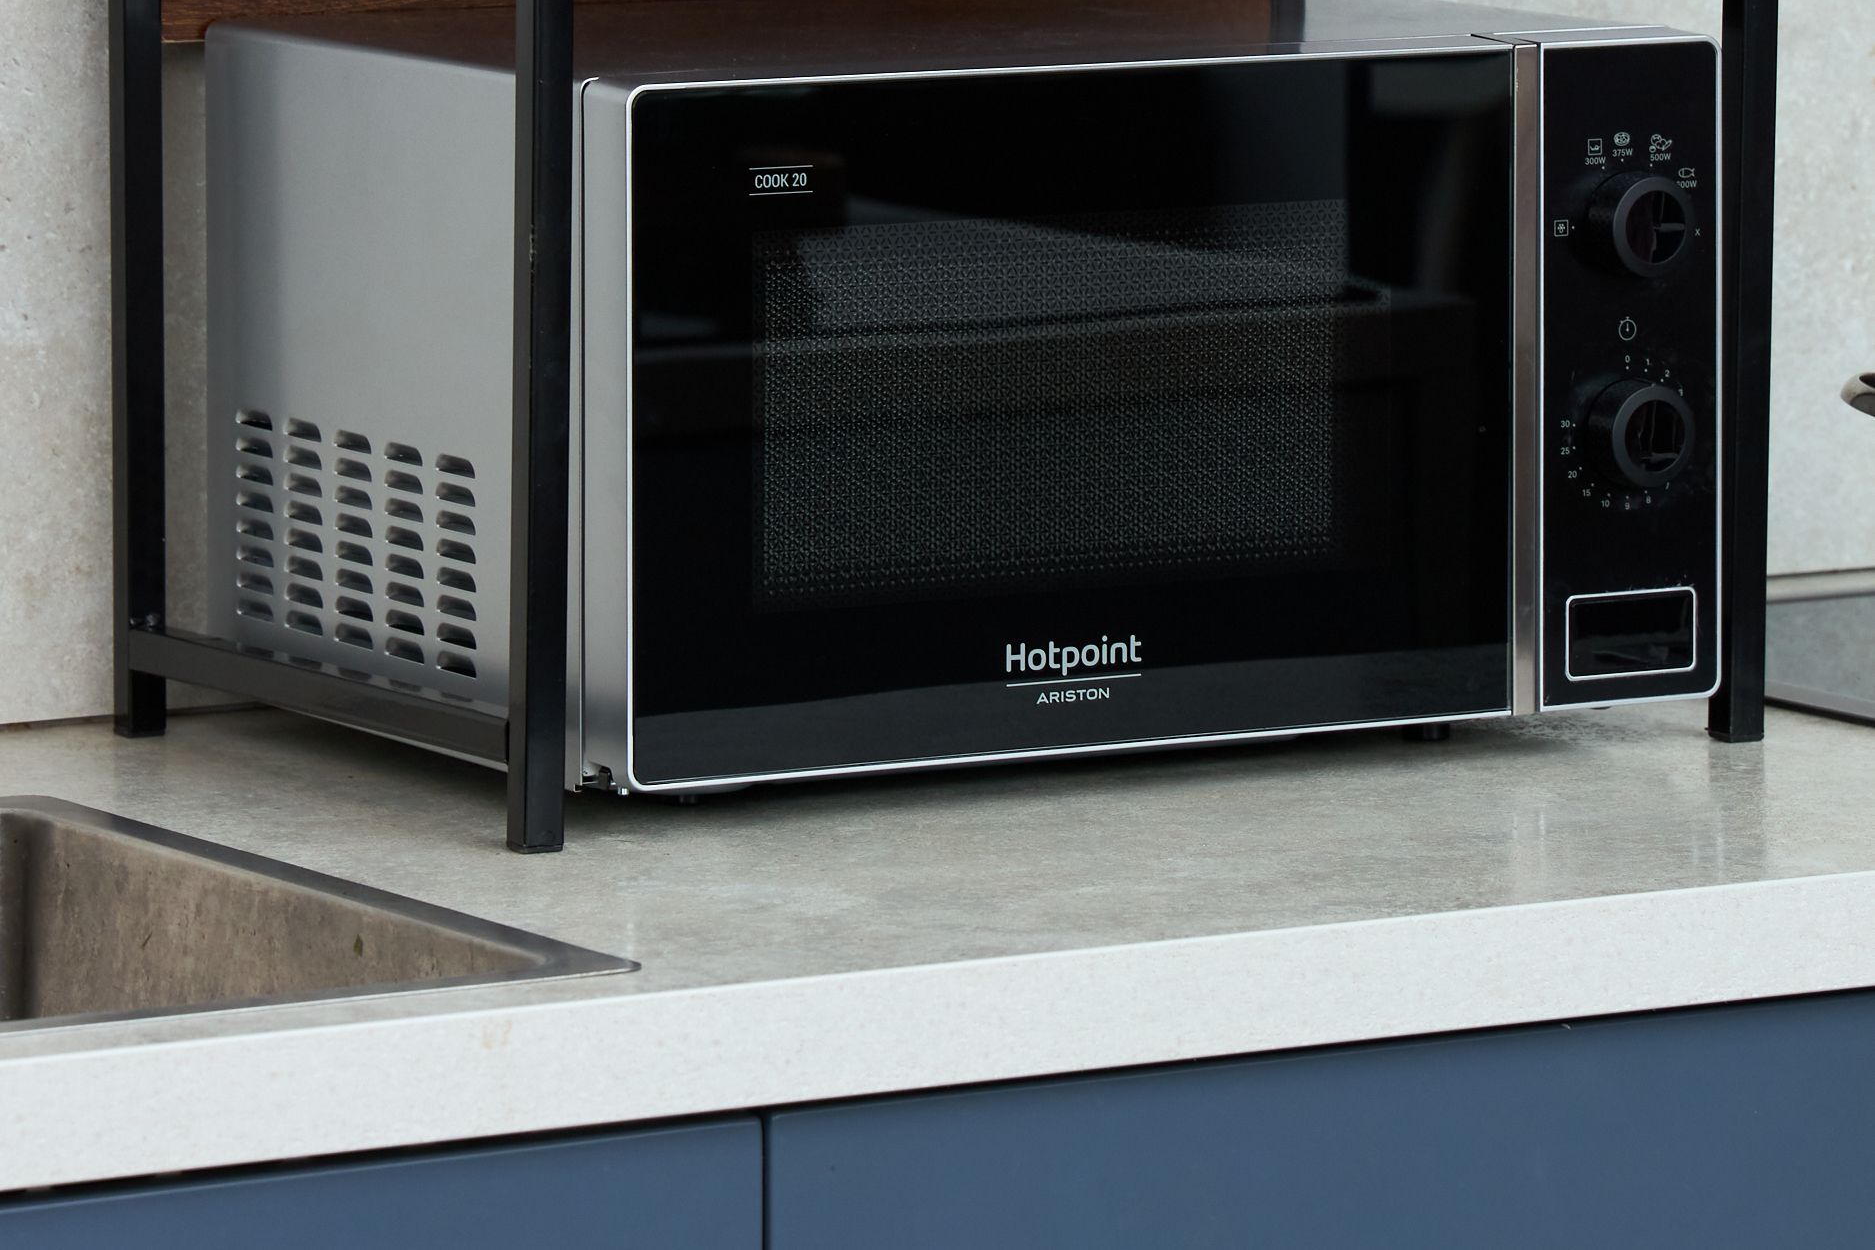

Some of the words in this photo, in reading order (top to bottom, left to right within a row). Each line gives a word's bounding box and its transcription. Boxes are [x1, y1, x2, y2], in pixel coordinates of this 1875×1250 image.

[1612, 149, 1633, 157] 375W
[1650, 153, 1671, 161] 500W
[1585, 157, 1606, 165] 300W
[755, 174, 789, 189] COOK
[792, 172, 807, 186] 20
[1676, 180, 1697, 188] 00W
[1006, 634, 1142, 676] Hotpoint
[1036, 688, 1110, 705] ARISTON
